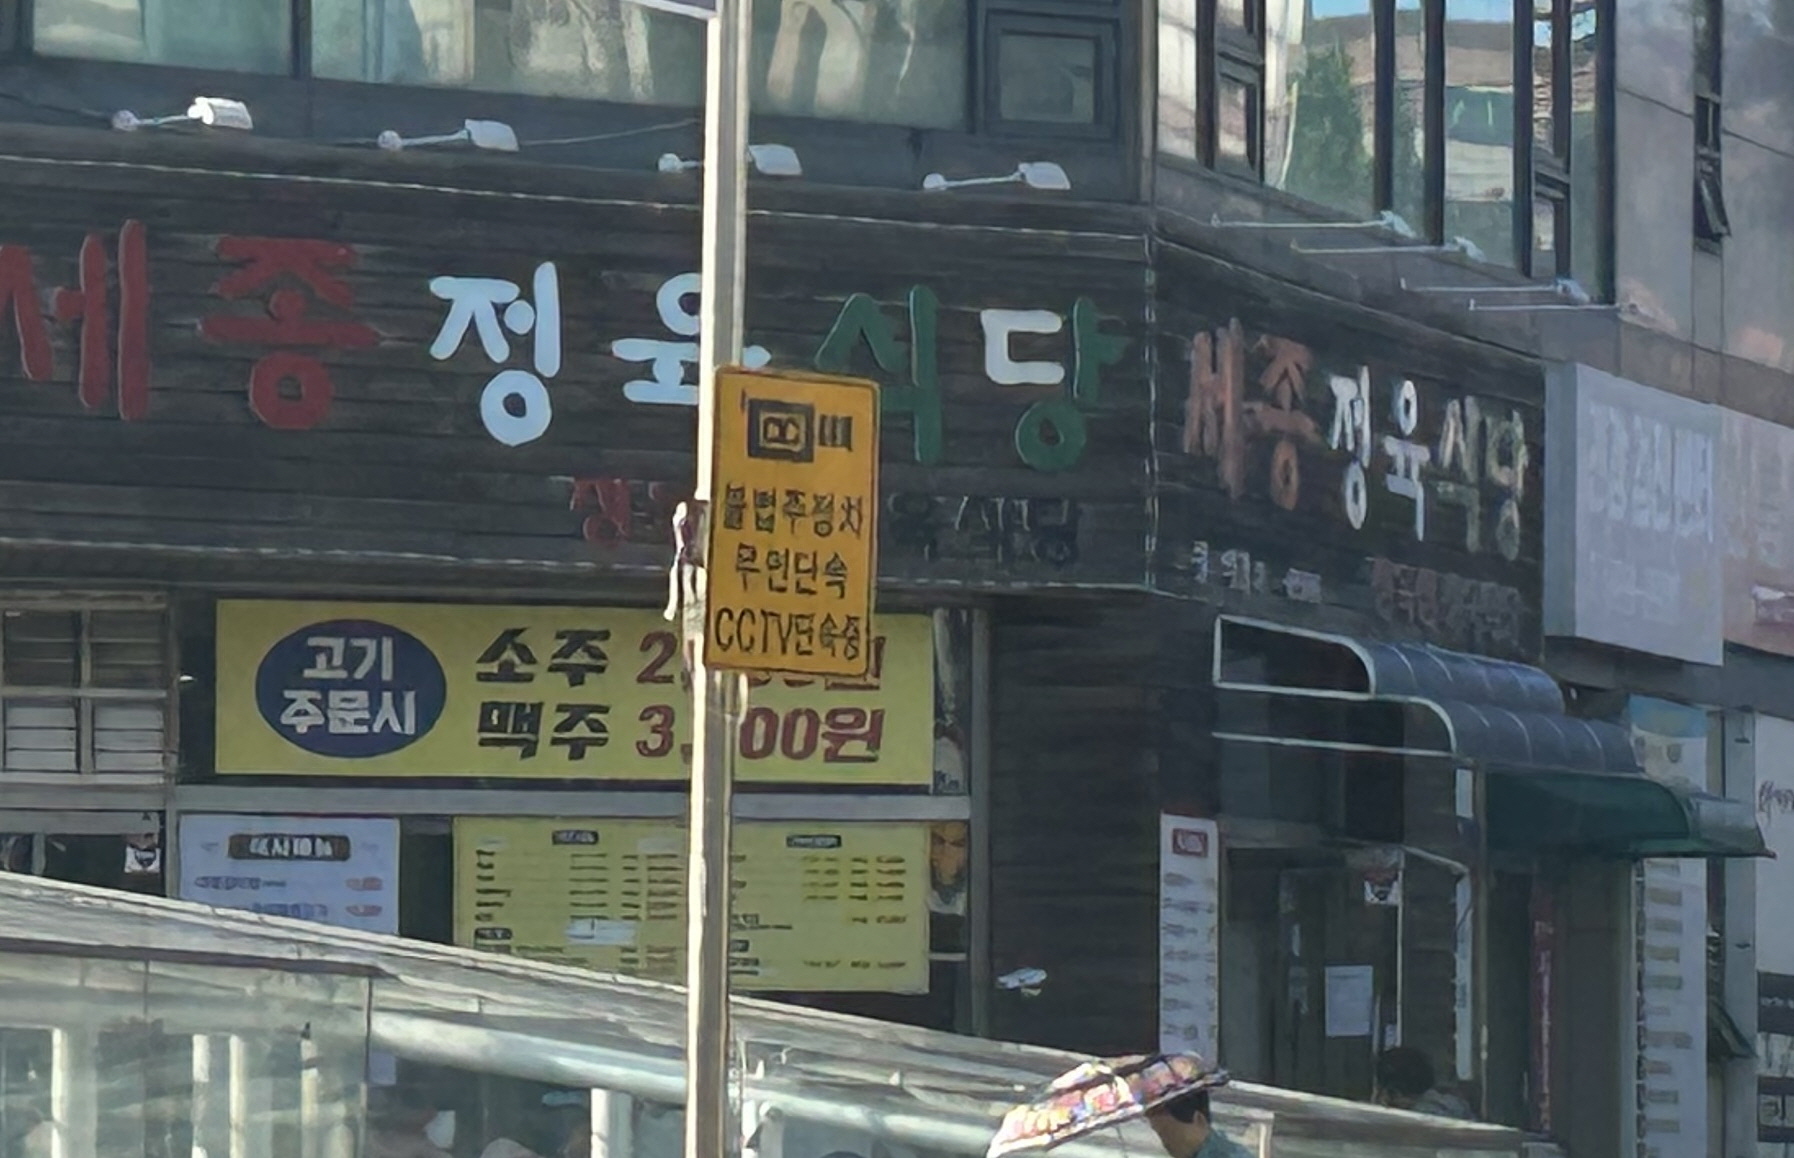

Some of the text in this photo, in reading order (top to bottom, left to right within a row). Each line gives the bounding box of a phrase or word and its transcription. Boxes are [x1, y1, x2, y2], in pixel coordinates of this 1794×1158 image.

[723, 482, 864, 539] 불법주정차
[735, 541, 849, 598] 무인단속
[302, 636, 394, 681] 고기
[476, 627, 611, 687] 소주
[714, 606, 861, 660] CCTV단속중
[280, 690, 417, 736] 주문시
[477, 700, 885, 764] 맥주 3,00원
